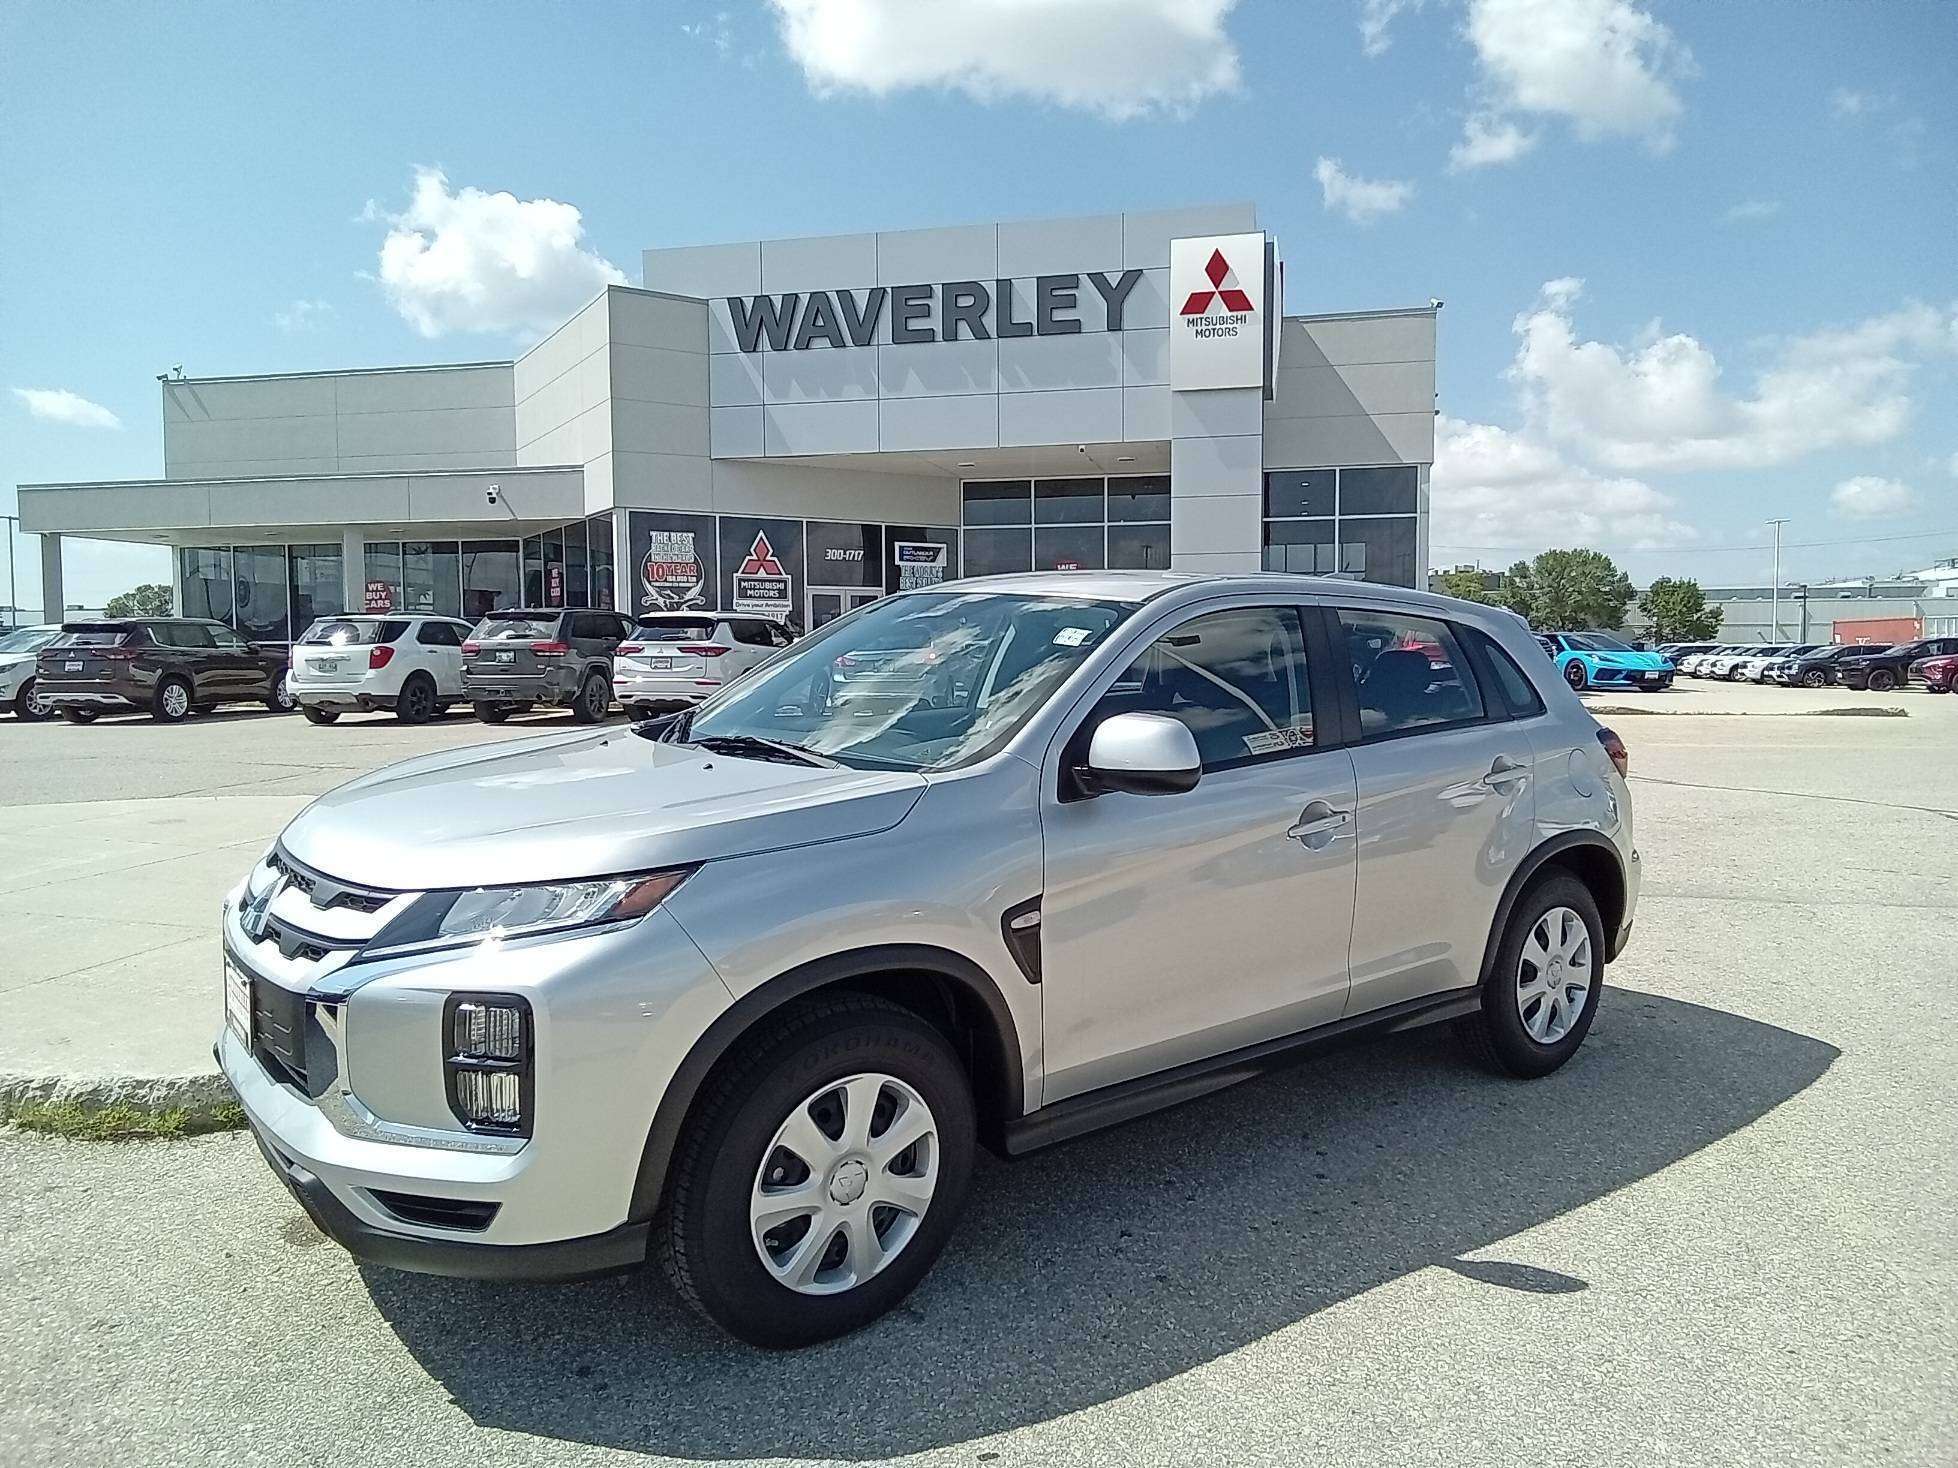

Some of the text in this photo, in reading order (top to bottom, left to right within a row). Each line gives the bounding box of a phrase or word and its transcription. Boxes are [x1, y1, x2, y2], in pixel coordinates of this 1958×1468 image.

[728, 269, 1144, 352] WAVERLEY
[1186, 314, 1248, 328] MITSUBISHI
[1195, 326, 1239, 339] MOTORS
[824, 549, 864, 561] 300-1717
[647, 563, 697, 581] 10 YEAR
[367, 583, 385, 591] WE
[740, 581, 785, 590] MITSUBISHI
[366, 591, 387, 600] BUY
[746, 589, 780, 598] MOTORS
[364, 599, 391, 608] CARS
